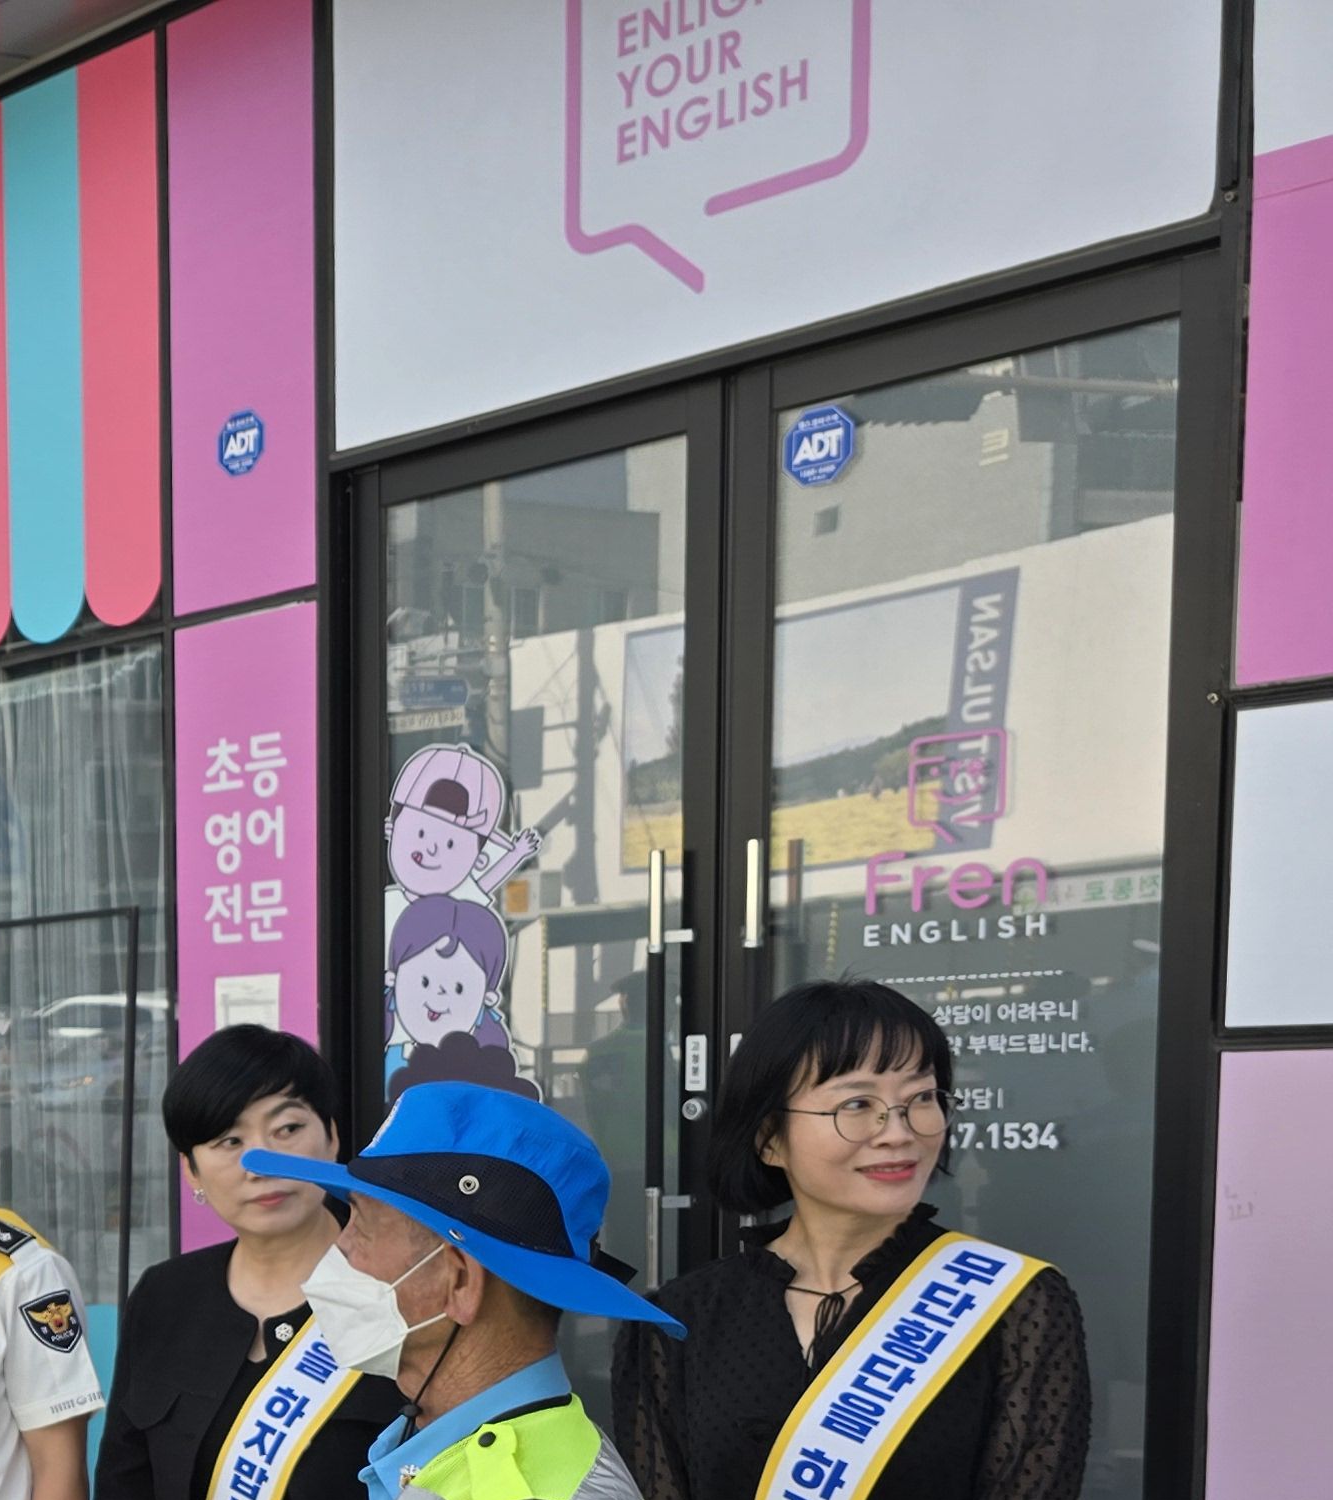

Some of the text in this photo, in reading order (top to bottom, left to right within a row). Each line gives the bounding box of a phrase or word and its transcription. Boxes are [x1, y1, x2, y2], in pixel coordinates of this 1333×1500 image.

[617, 0, 764, 58] ENLIG
[617, 30, 743, 110] YOUR
[617, 59, 810, 165] ENGLISH
[224, 428, 258, 460] ADT
[793, 427, 844, 466] ADT
[202, 732, 288, 798] 초등
[204, 805, 286, 874] 영어
[205, 879, 288, 945] 전문
[865, 851, 1048, 916] Fren
[863, 912, 1048, 948] ENGLISH
[933, 999, 1079, 1027] 상담이 어려우니
[947, 1031, 1095, 1057] 약 부탁드립니다.
[949, 1121, 1060, 1150] 7.1534
[820, 1249, 1008, 1446] 무단횡단을
